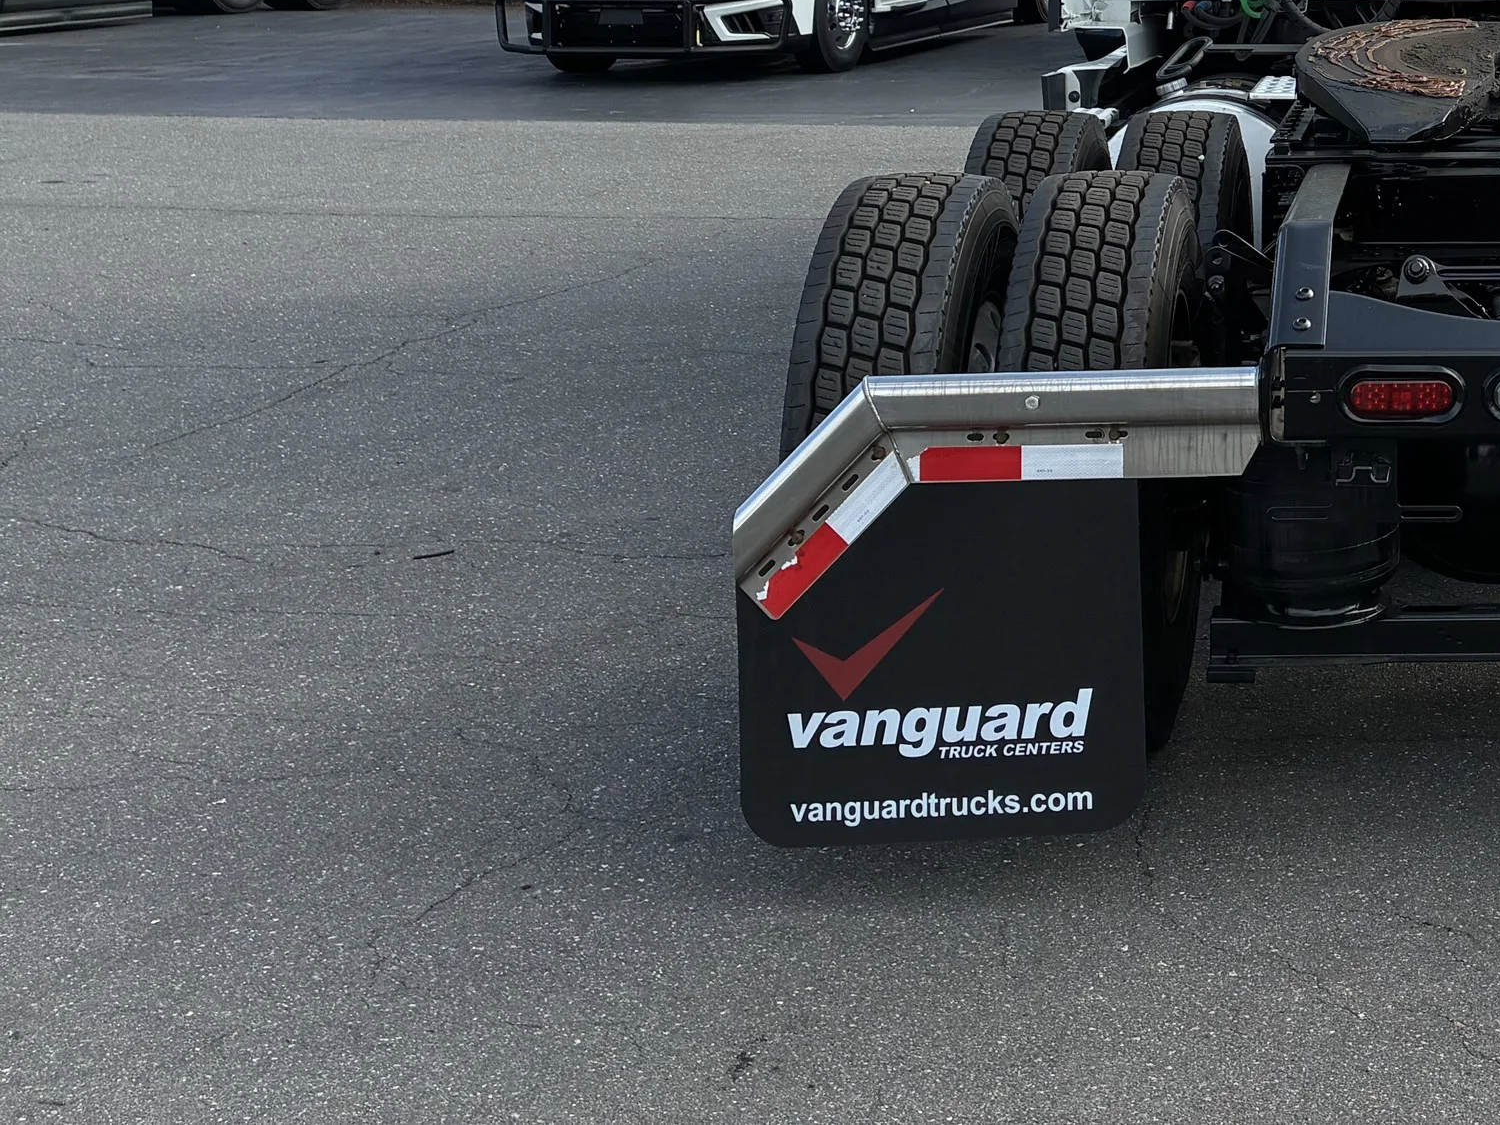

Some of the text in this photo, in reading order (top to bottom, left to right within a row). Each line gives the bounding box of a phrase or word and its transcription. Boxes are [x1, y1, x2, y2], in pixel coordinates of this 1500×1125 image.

[787, 687, 1094, 758] vanguard
[938, 740, 1085, 759] TRUCK CENTERS
[790, 790, 1093, 827] vanguardtrucks.com
